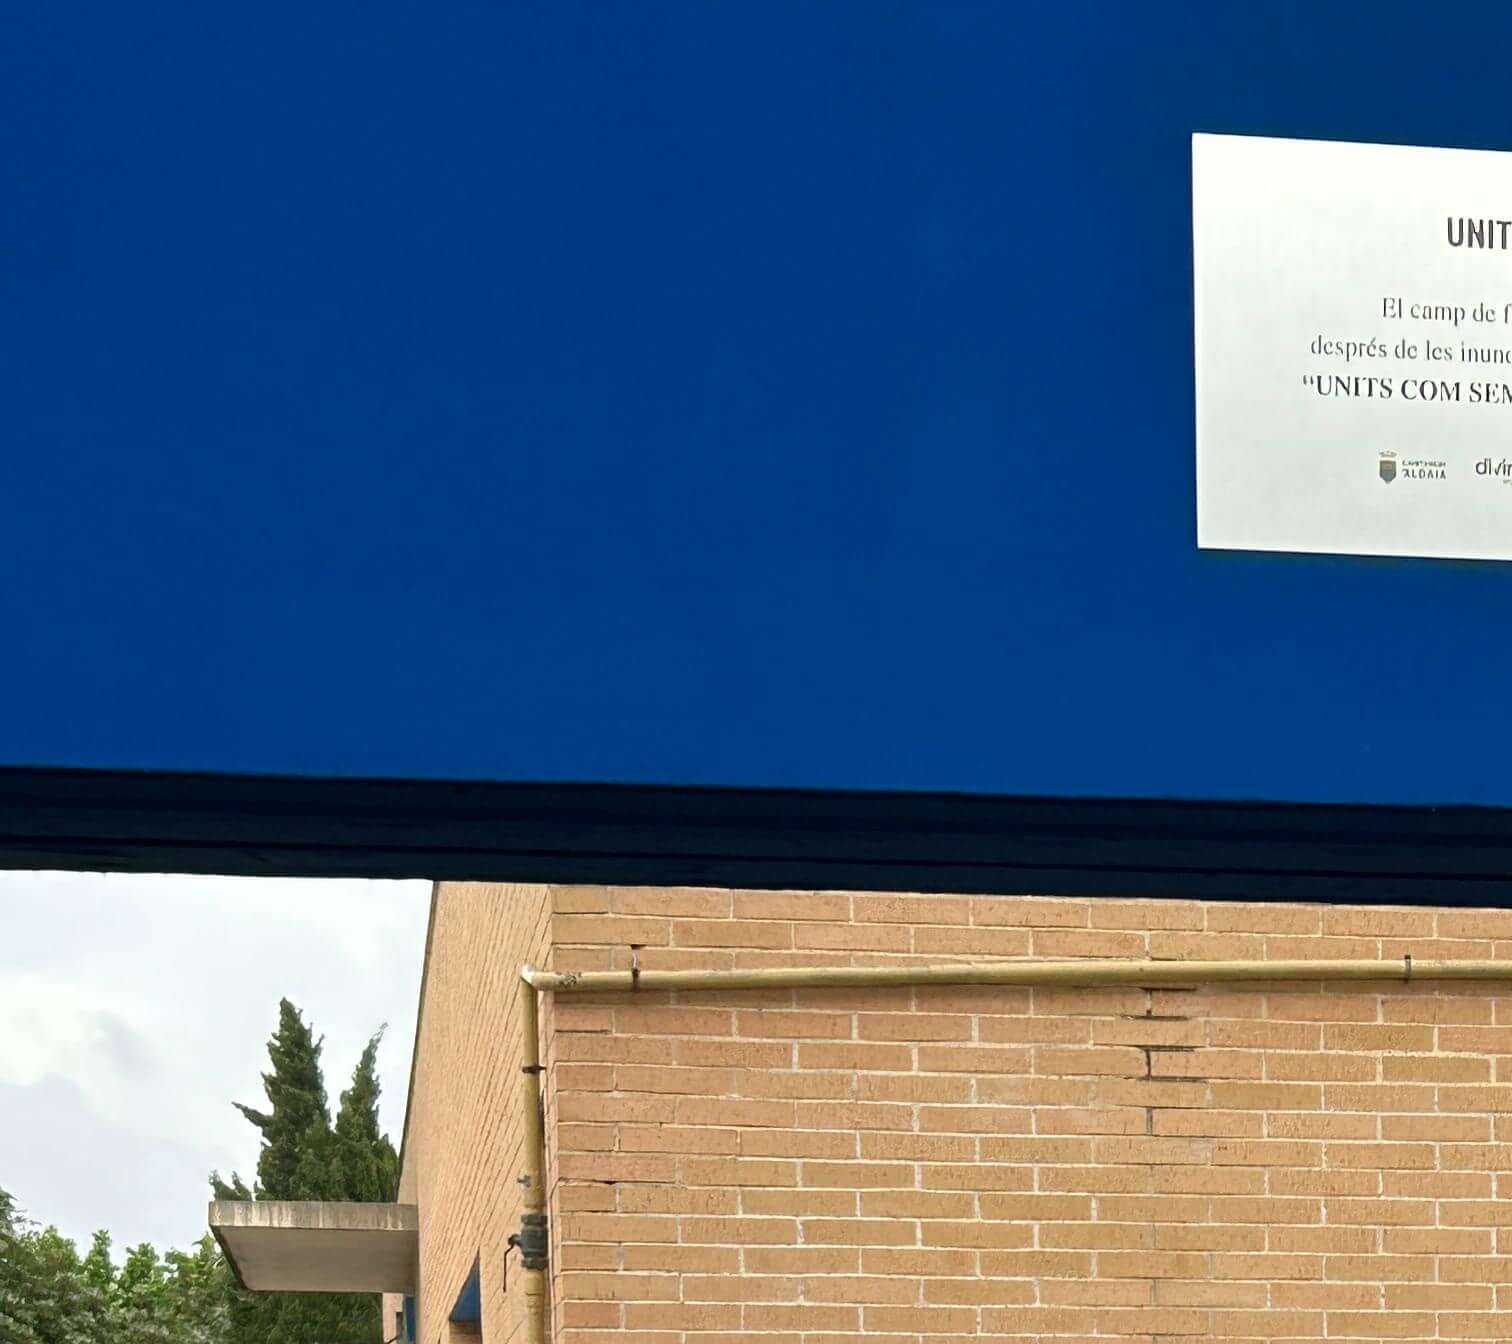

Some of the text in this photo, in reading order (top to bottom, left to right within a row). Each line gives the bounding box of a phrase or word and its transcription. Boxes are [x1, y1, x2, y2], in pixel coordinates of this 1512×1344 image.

[1382, 297, 1401, 319] El
[1410, 303, 1465, 327] camp
[1472, 302, 1496, 323] de
[1311, 335, 1387, 362] després
[1395, 339, 1418, 359] de
[1426, 339, 1453, 361] les
[1400, 378, 1460, 402] COM
